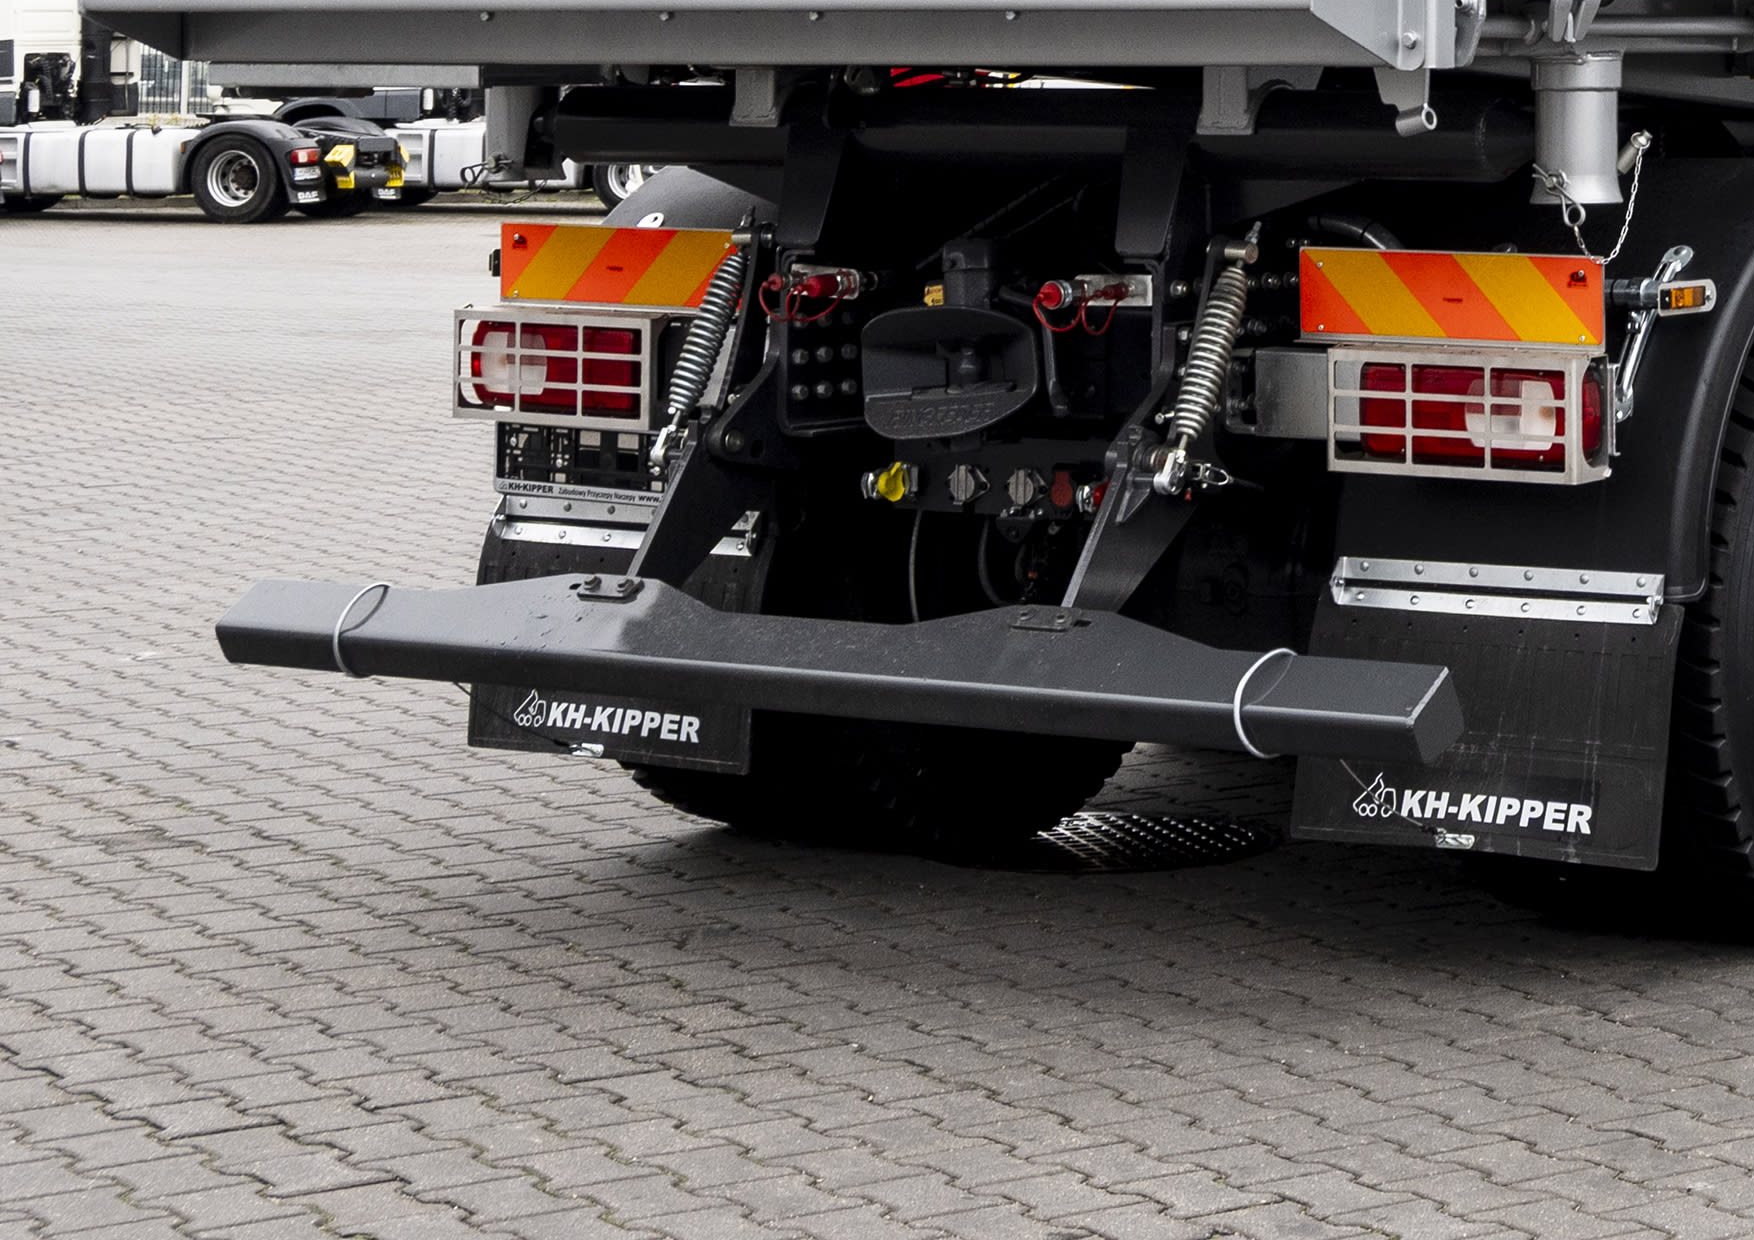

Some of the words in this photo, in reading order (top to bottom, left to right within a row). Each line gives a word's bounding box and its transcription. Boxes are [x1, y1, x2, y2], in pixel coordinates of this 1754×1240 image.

[297, 190, 319, 200] DAF
[378, 188, 396, 196] DAF
[508, 481, 554, 494] KH-KIPPER
[546, 700, 700, 744] KH-KIPPER
[1400, 789, 1593, 834] KH-KIPPER
